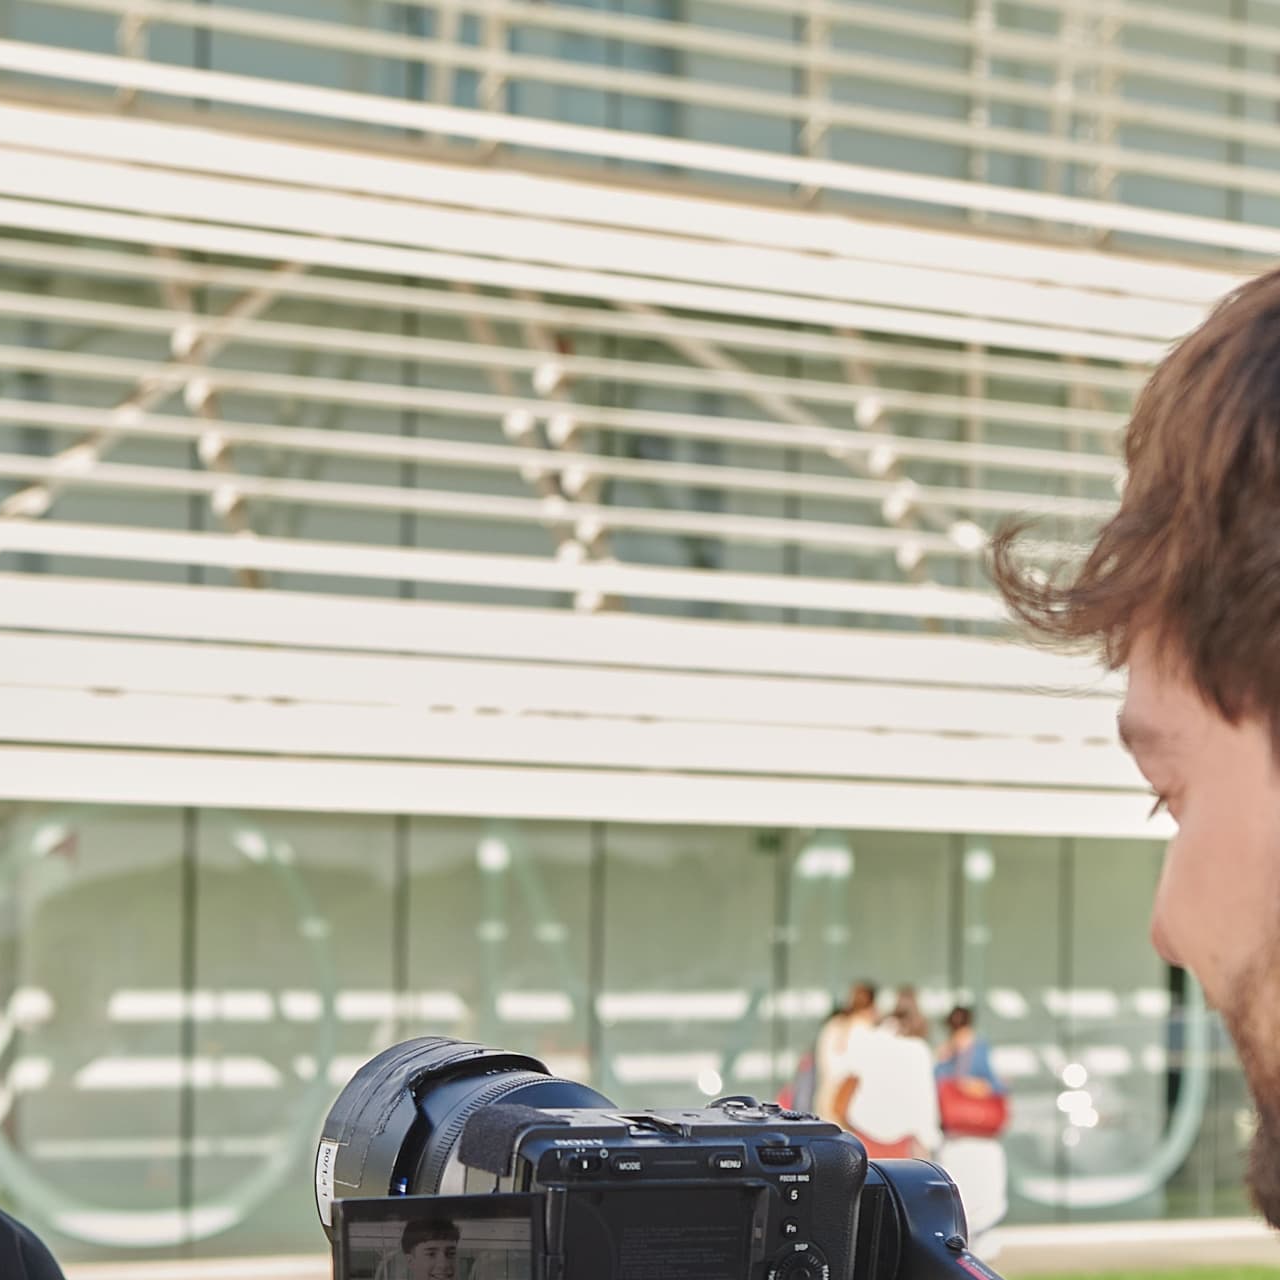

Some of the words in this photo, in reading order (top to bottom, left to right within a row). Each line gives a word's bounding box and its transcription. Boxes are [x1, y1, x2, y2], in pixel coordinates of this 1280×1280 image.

[619, 1161, 641, 1171] MODE
[719, 1159, 742, 1169] MENU
[790, 1190, 798, 1201] 5
[786, 1224, 797, 1233] Fn
